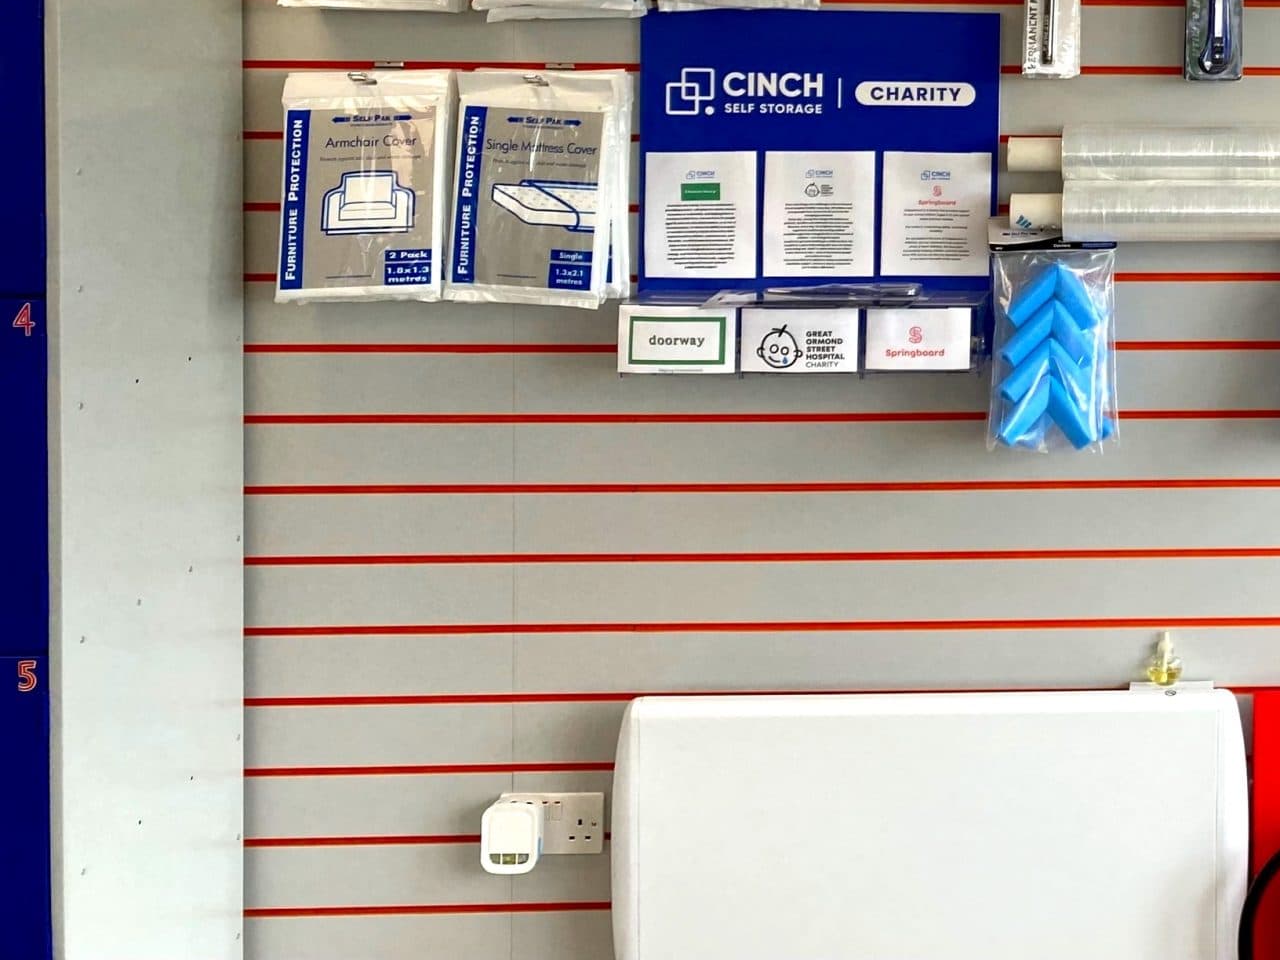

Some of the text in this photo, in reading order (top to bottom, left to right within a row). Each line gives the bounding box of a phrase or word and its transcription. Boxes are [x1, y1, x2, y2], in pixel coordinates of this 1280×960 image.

[723, 71, 823, 98] CINCH
[870, 86, 962, 101] CHARITY
[724, 102, 822, 115] SELF STORAGE
[325, 134, 417, 148] Armchair Cover
[486, 138, 597, 155] Single Mattress Cover
[285, 120, 303, 280] FURNITURE PROTECTION
[457, 116, 481, 274] FURNITURE PROTECTION
[389, 251, 397, 259] 2
[559, 251, 583, 260] Single
[13, 302, 36, 337] 4
[649, 334, 705, 347] doorway
[885, 349, 945, 358] Springboard
[18, 660, 37, 691] 5
